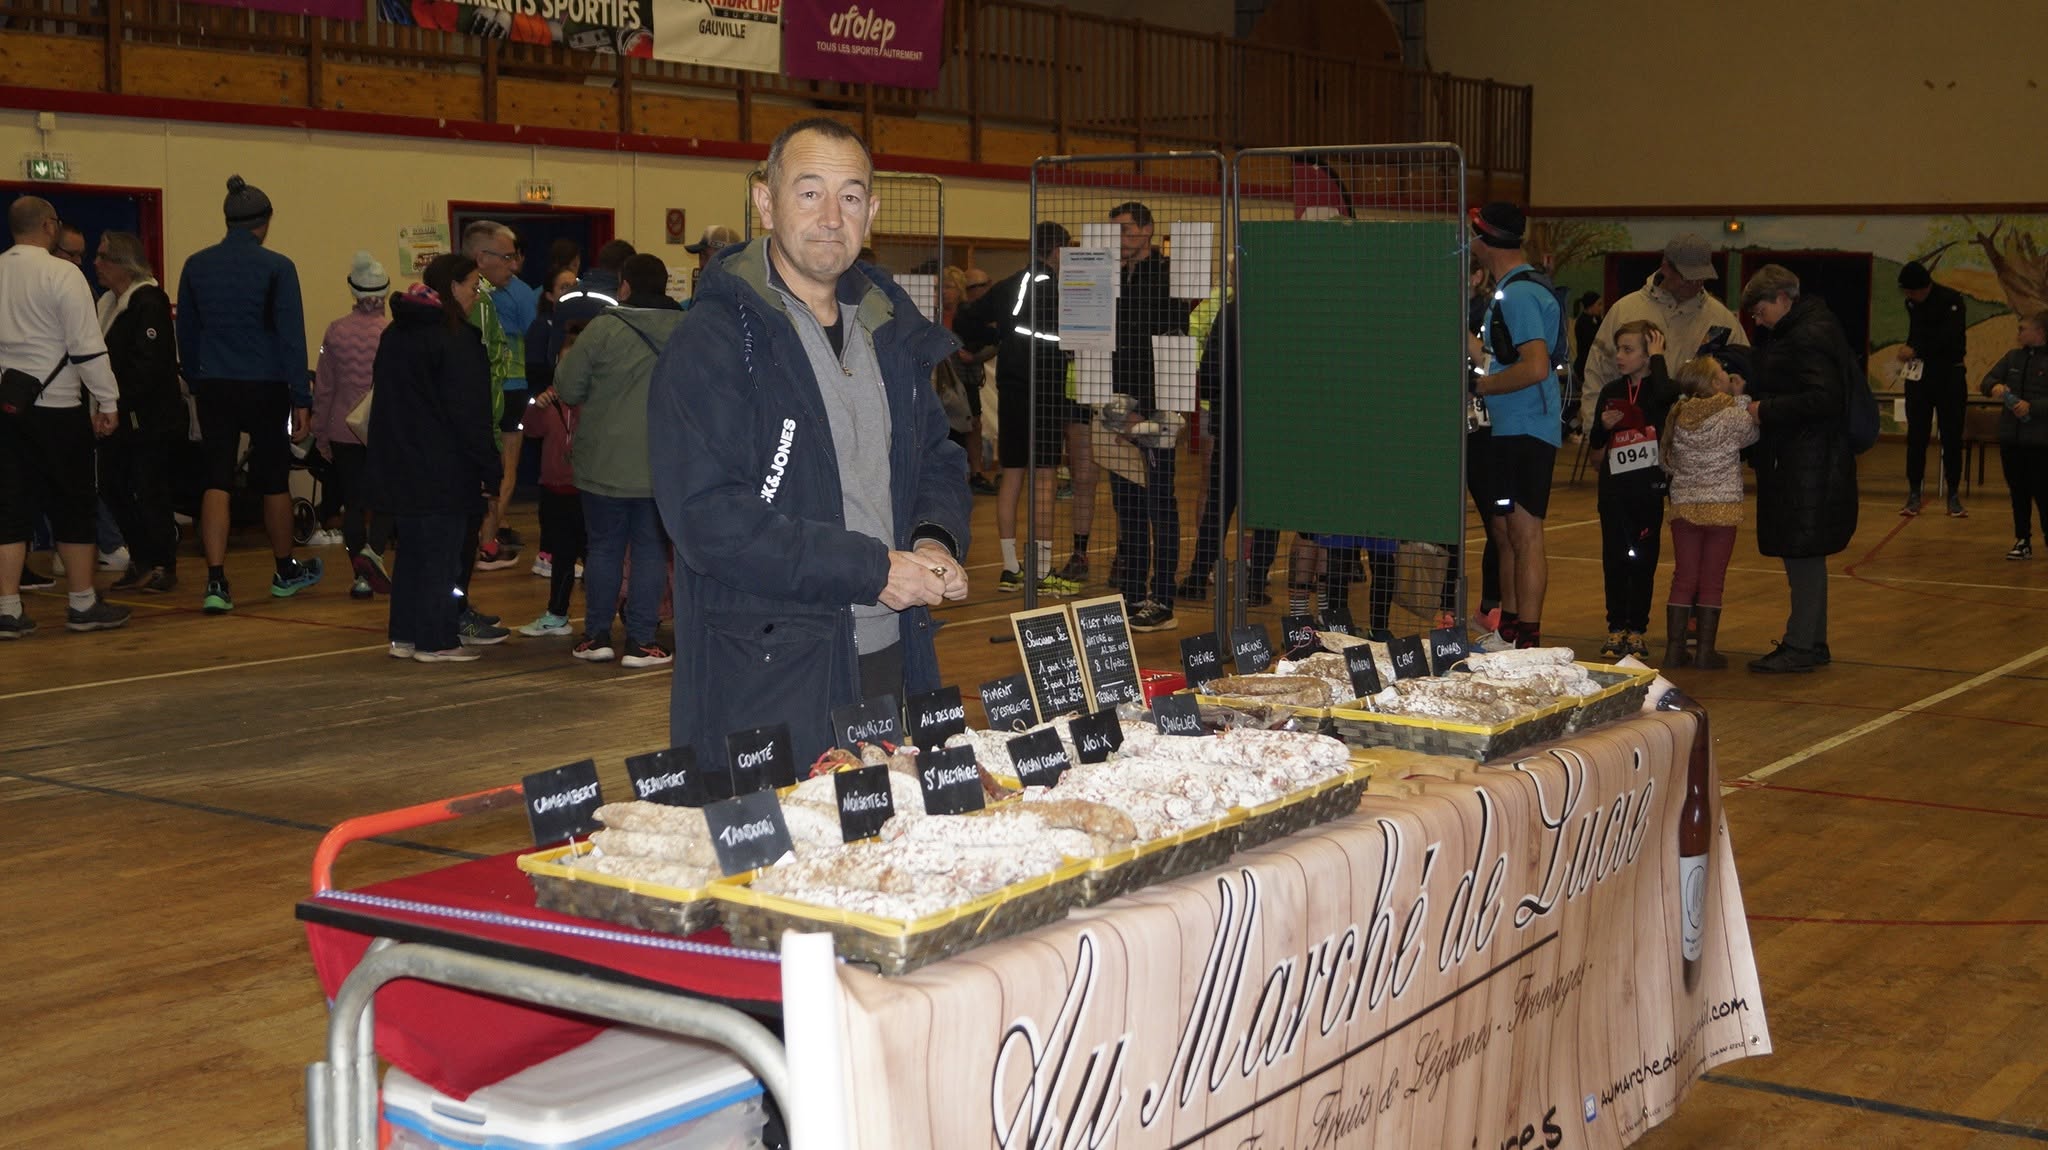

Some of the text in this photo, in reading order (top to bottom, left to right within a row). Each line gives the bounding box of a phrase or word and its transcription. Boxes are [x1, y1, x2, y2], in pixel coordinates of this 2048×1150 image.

[542, 0, 641, 30] SPORTIFS
[699, 19, 746, 39] GAUVILLE
[829, 4, 896, 56] ufolep
[816, 41, 923, 61] TOUS LES SPORTS AUTREMENT
[1617, 446, 1649, 465] 094
[1038, 660, 1046, 674] 1
[1094, 659, 1101, 672] 8
[1188, 650, 1216, 667] CHÈVRE
[1042, 677, 1049, 690] 3
[737, 741, 775, 769] COMTÉ
[636, 770, 687, 798] BEAUFORT
[533, 781, 599, 814] CAMEMBERT
[1140, 868, 1441, 1128] Marché
[1438, 786, 1508, 973] de
[1513, 748, 1655, 930] Lucie
[1313, 968, 1586, 1145] Fruits & Légumes Fromages
